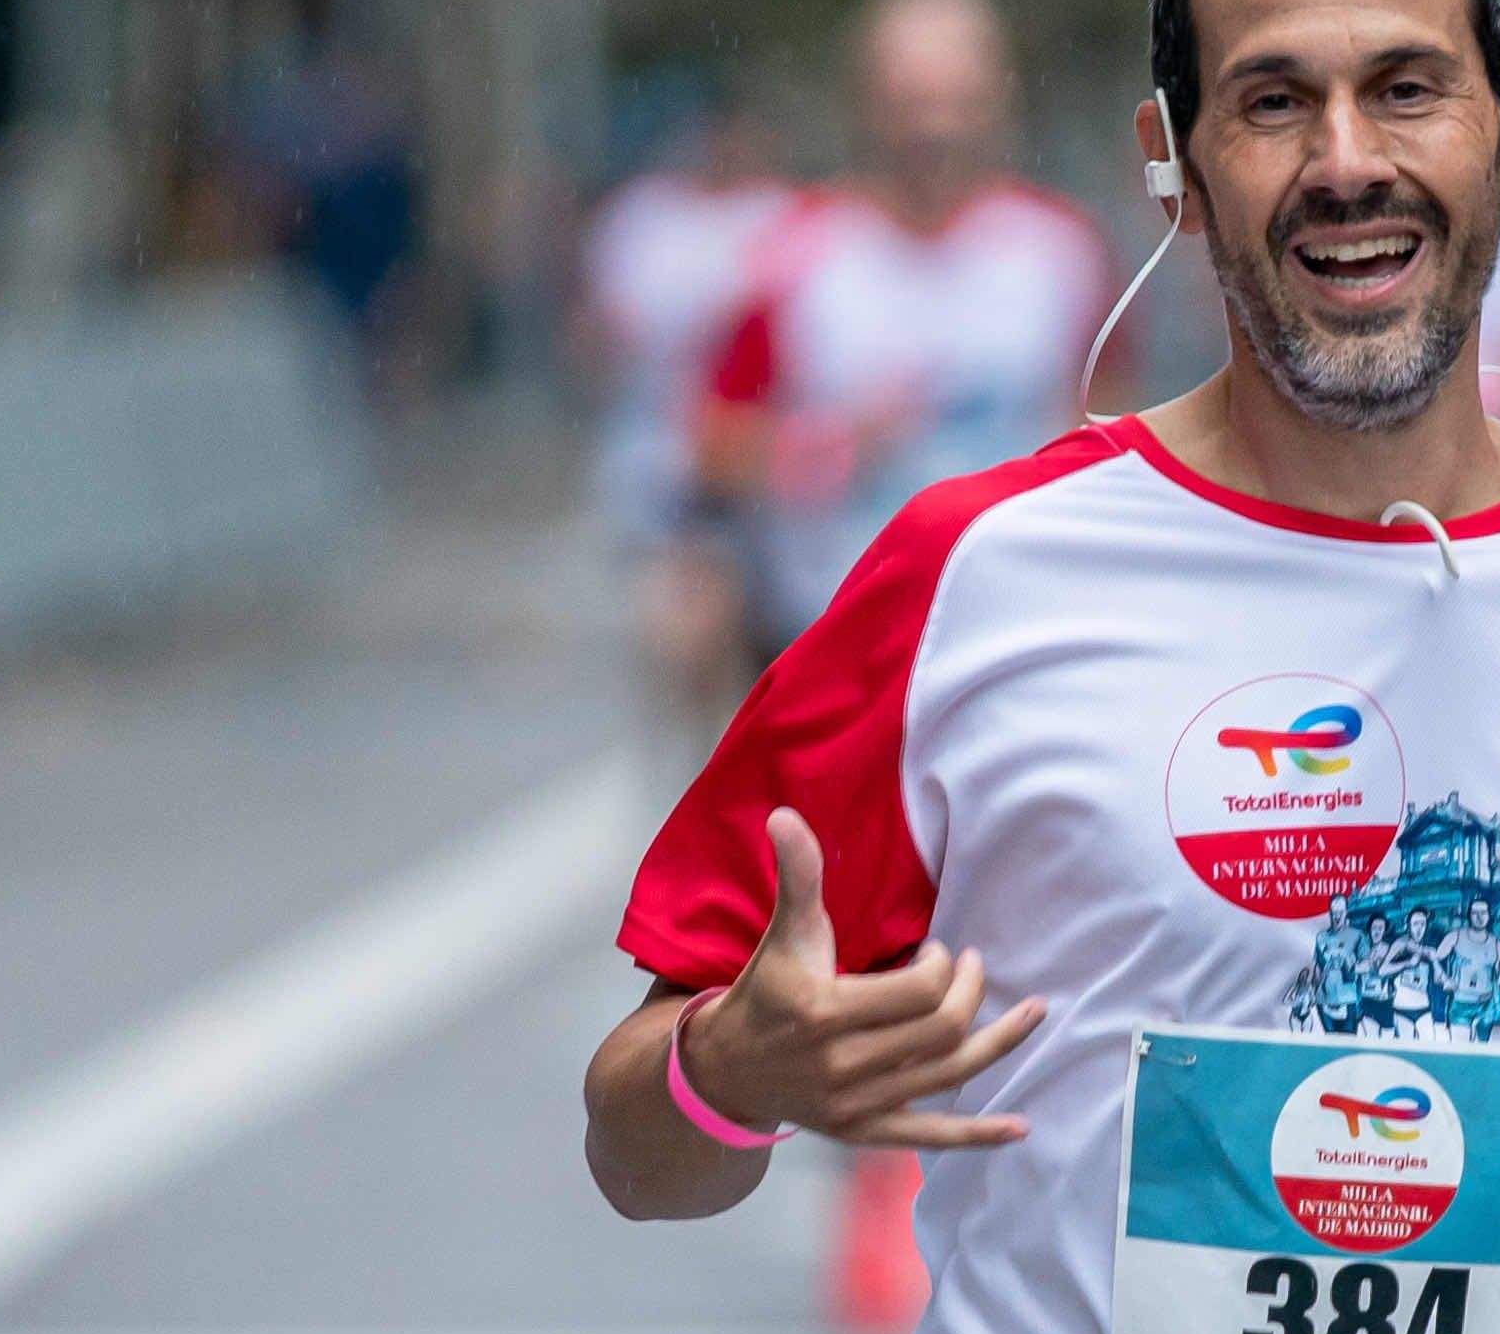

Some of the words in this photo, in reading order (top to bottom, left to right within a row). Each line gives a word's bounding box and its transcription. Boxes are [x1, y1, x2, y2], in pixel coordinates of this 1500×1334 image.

[1222, 787, 1364, 813] TotalEnergies
[1263, 834, 1326, 854] MILLA
[1212, 854, 1370, 880] INTERNACIONAL
[1241, 880, 1271, 900] DE
[1275, 877, 1348, 899] MADRID
[1316, 1148, 1429, 1172] TotalEnergies
[1341, 1184, 1394, 1203] MILLA
[1299, 1198, 1433, 1224] INTERNACIONAL
[1317, 1218, 1342, 1235] DE
[1344, 1219, 1412, 1238] MADRID
